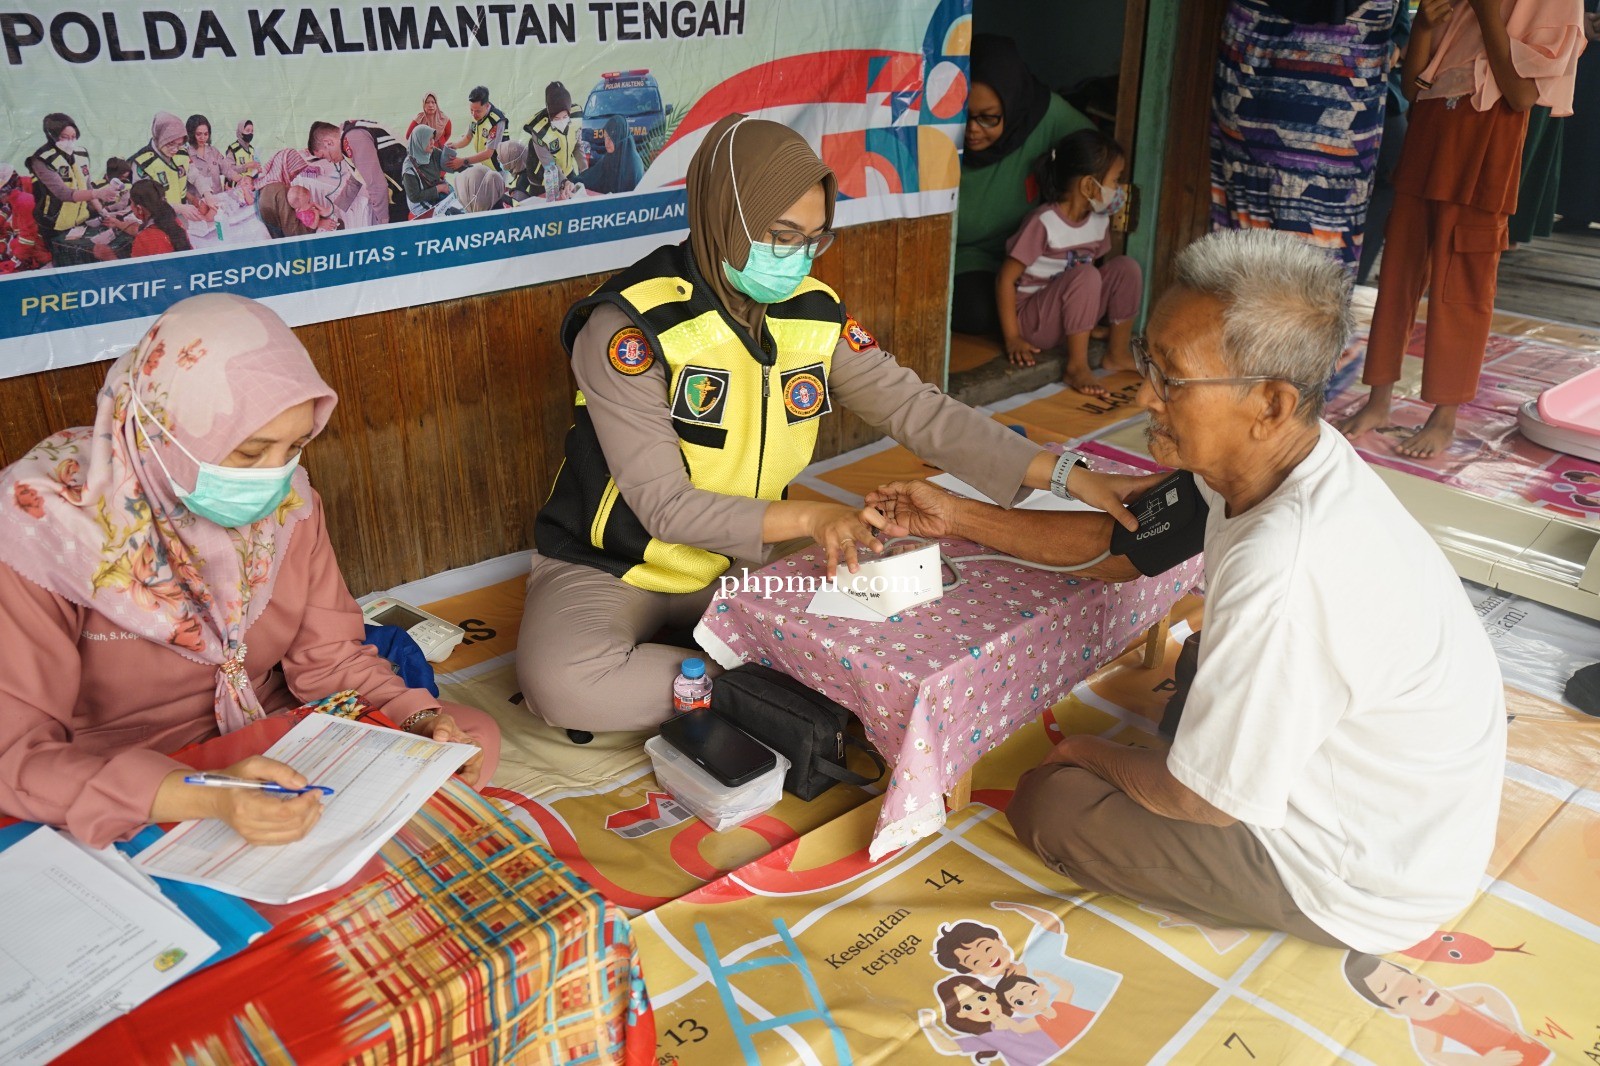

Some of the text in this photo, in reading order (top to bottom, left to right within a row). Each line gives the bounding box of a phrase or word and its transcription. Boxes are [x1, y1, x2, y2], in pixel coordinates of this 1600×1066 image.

[0, 0, 746, 65] POLDA KALIMANTAN TENGAH
[21, 278, 167, 317] PREDIKTIF
[190, 245, 395, 291] RESPONSIBILITAS
[414, 221, 562, 257] TRANSPARANSI
[567, 203, 685, 234] BERKEADILAN
[924, 868, 965, 891] 14
[824, 908, 912, 970] Kesehatan
[861, 934, 923, 976] terjaga
[664, 1018, 709, 1047] 13
[1223, 1031, 1256, 1060] 7
